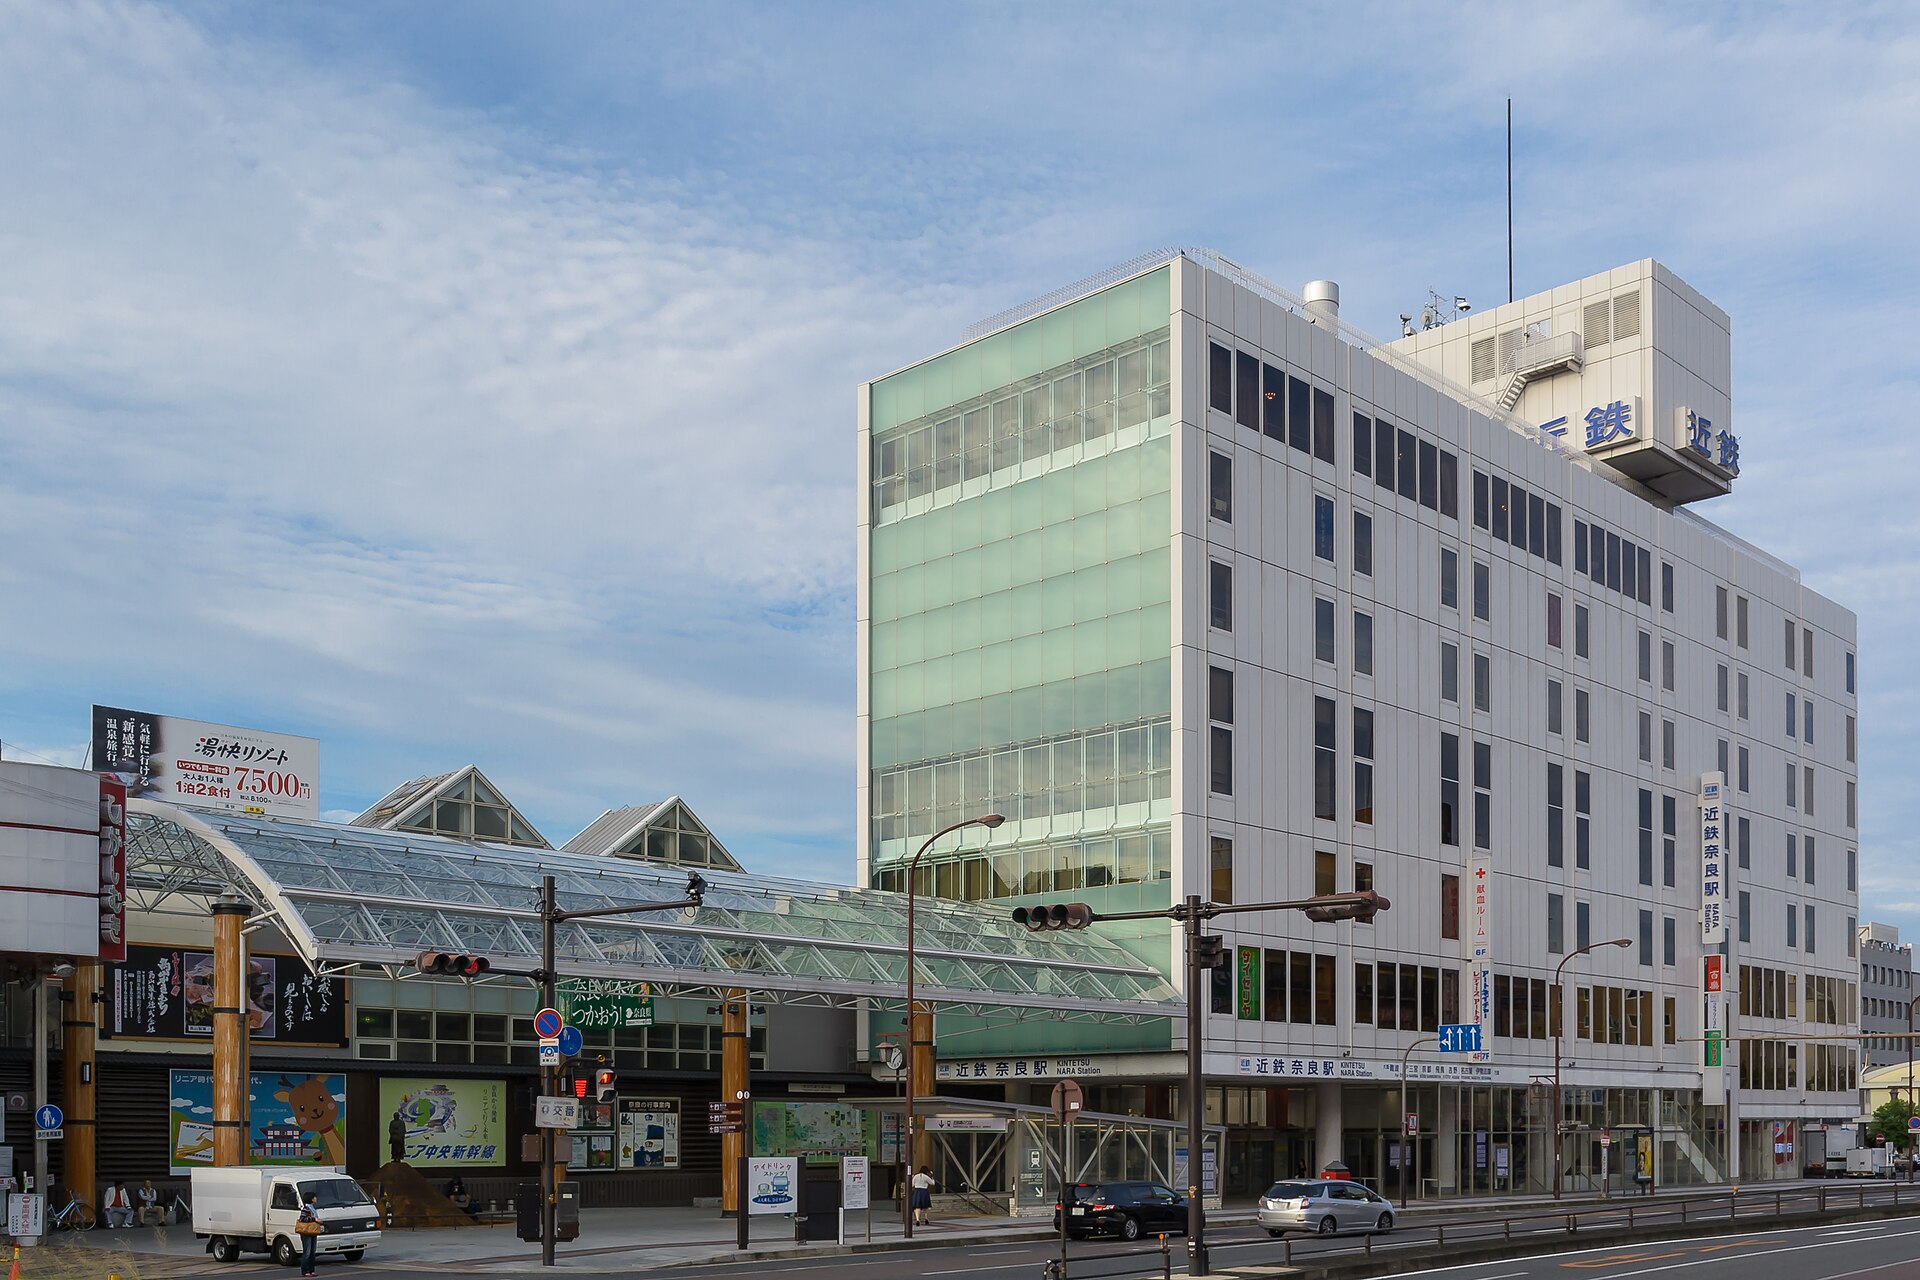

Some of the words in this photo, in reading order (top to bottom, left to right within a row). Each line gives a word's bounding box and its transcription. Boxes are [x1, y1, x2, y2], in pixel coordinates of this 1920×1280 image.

[1687, 407, 1740, 475] 近鉄
[106, 718, 118, 767] 温泉旅行。
[194, 737, 289, 766] 湯快リゾート
[139, 722, 150, 786] 気軽に行ける
[178, 761, 229, 776] いつでも同一料金
[175, 781, 231, 799] 1泊2食付
[1704, 807, 1719, 897] 近鉄奈良駅
[1476, 885, 1485, 936] 献血ルーム
[1242, 950, 1251, 1017] サイゼリヤ
[633, 1007, 652, 1018] 奈良県
[956, 1060, 1048, 1077] 近鉄奈良駅
[1056, 1059, 1091, 1067] KINTETSU
[1056, 1067, 1076, 1075] NARA
[1078, 1066, 1101, 1075] Station
[1256, 1058, 1334, 1076] 近鉄奈良駅
[1356, 1070, 1373, 1078] Station
[553, 1105, 575, 1117] 交番
